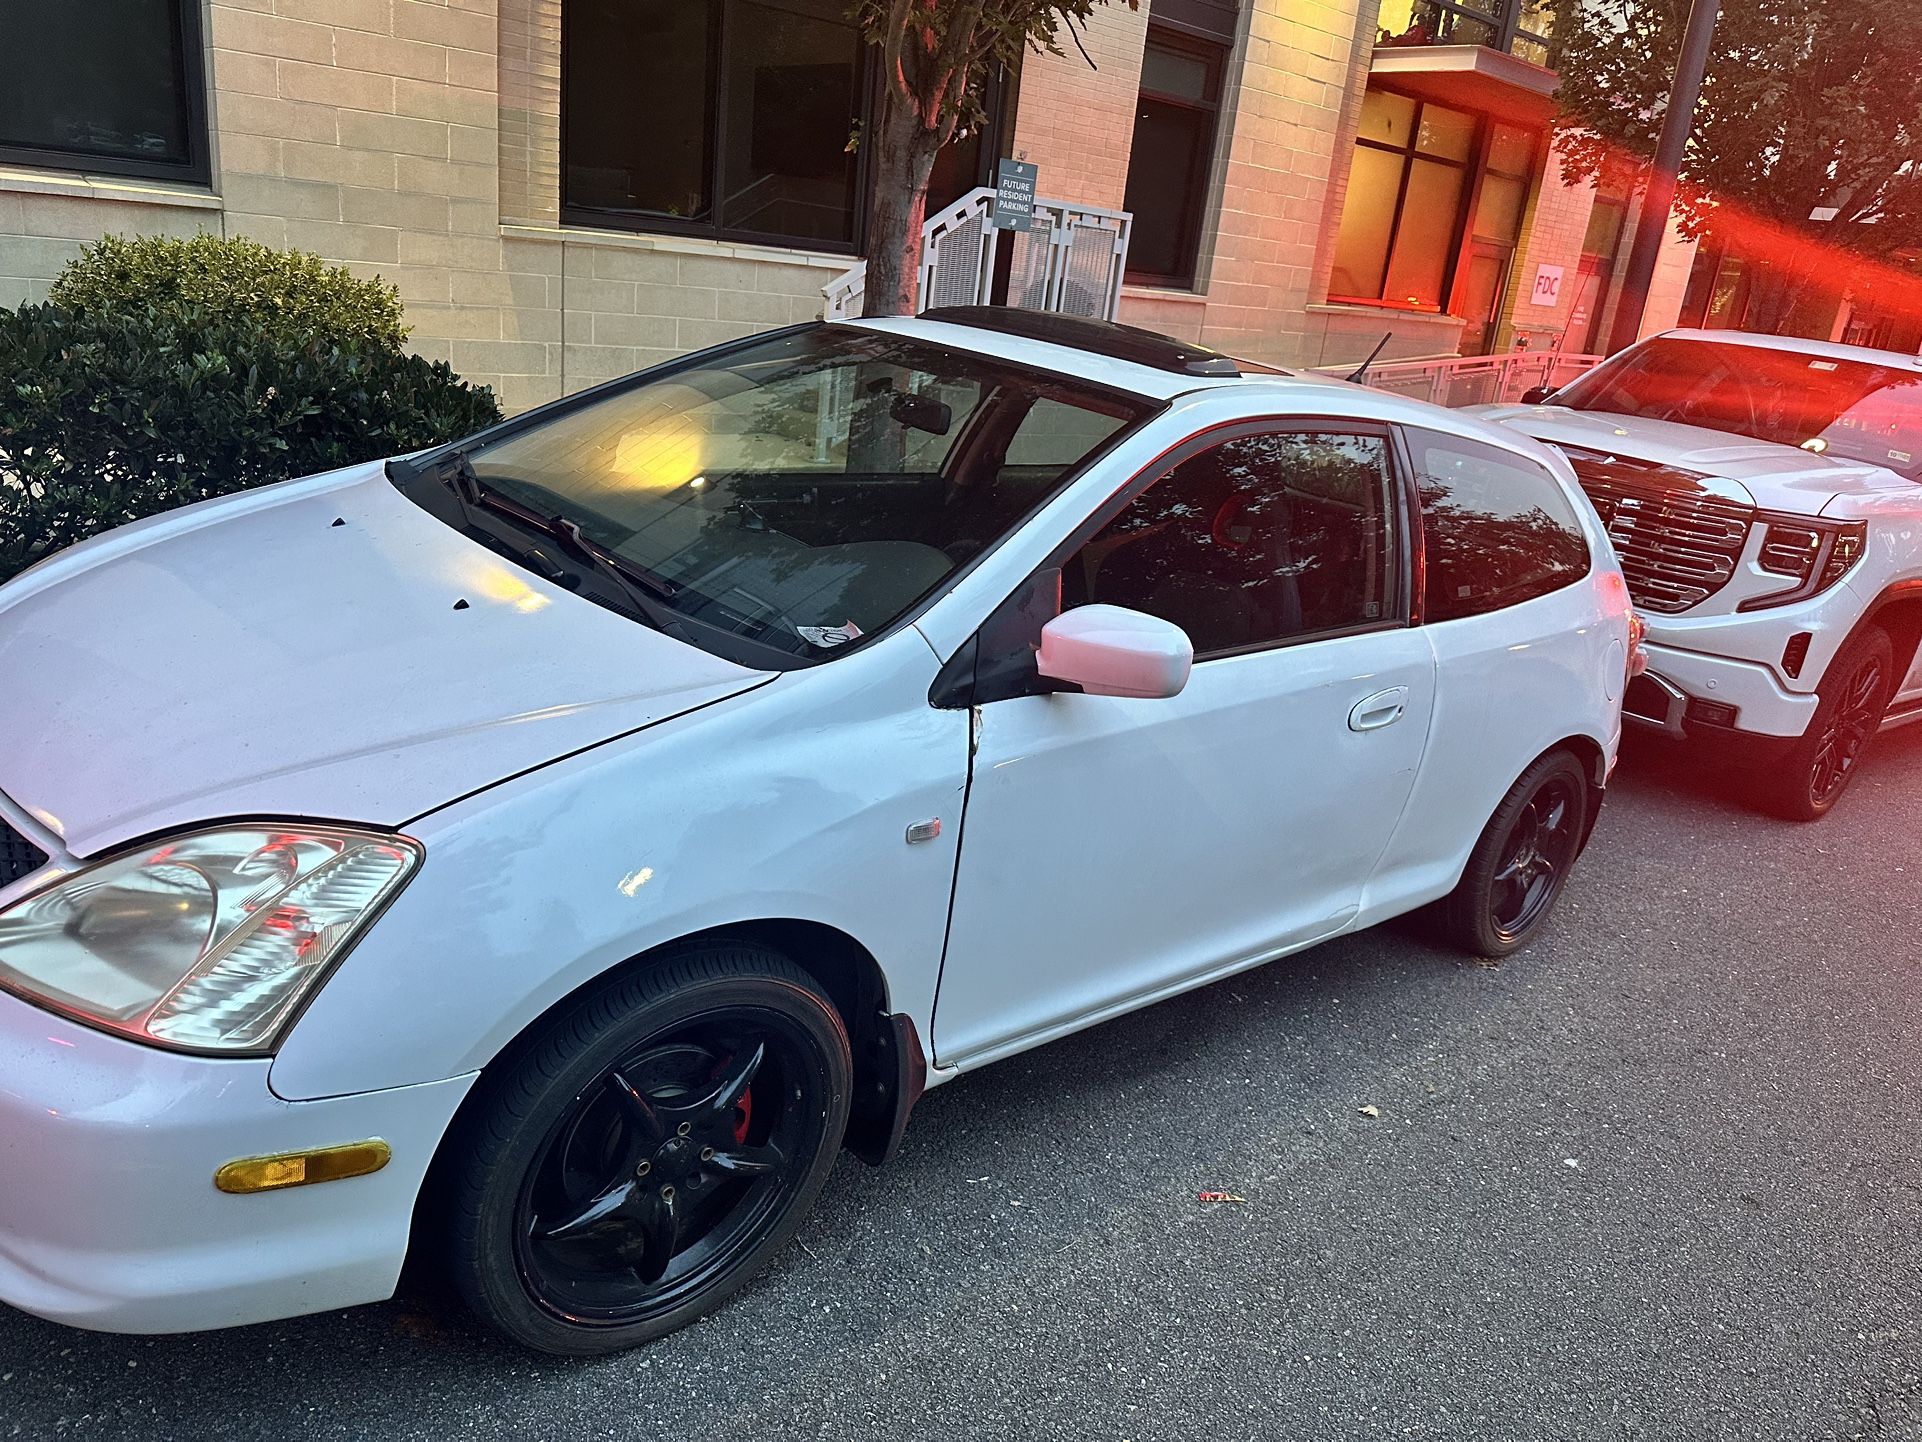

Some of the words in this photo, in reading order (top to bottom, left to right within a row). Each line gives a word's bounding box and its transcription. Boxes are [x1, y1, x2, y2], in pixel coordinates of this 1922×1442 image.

[1002, 179, 1030, 192] FUTURE
[999, 189, 1032, 202] RESIDENT
[999, 200, 1029, 212] PARKING
[1535, 275, 1558, 296] FDC
